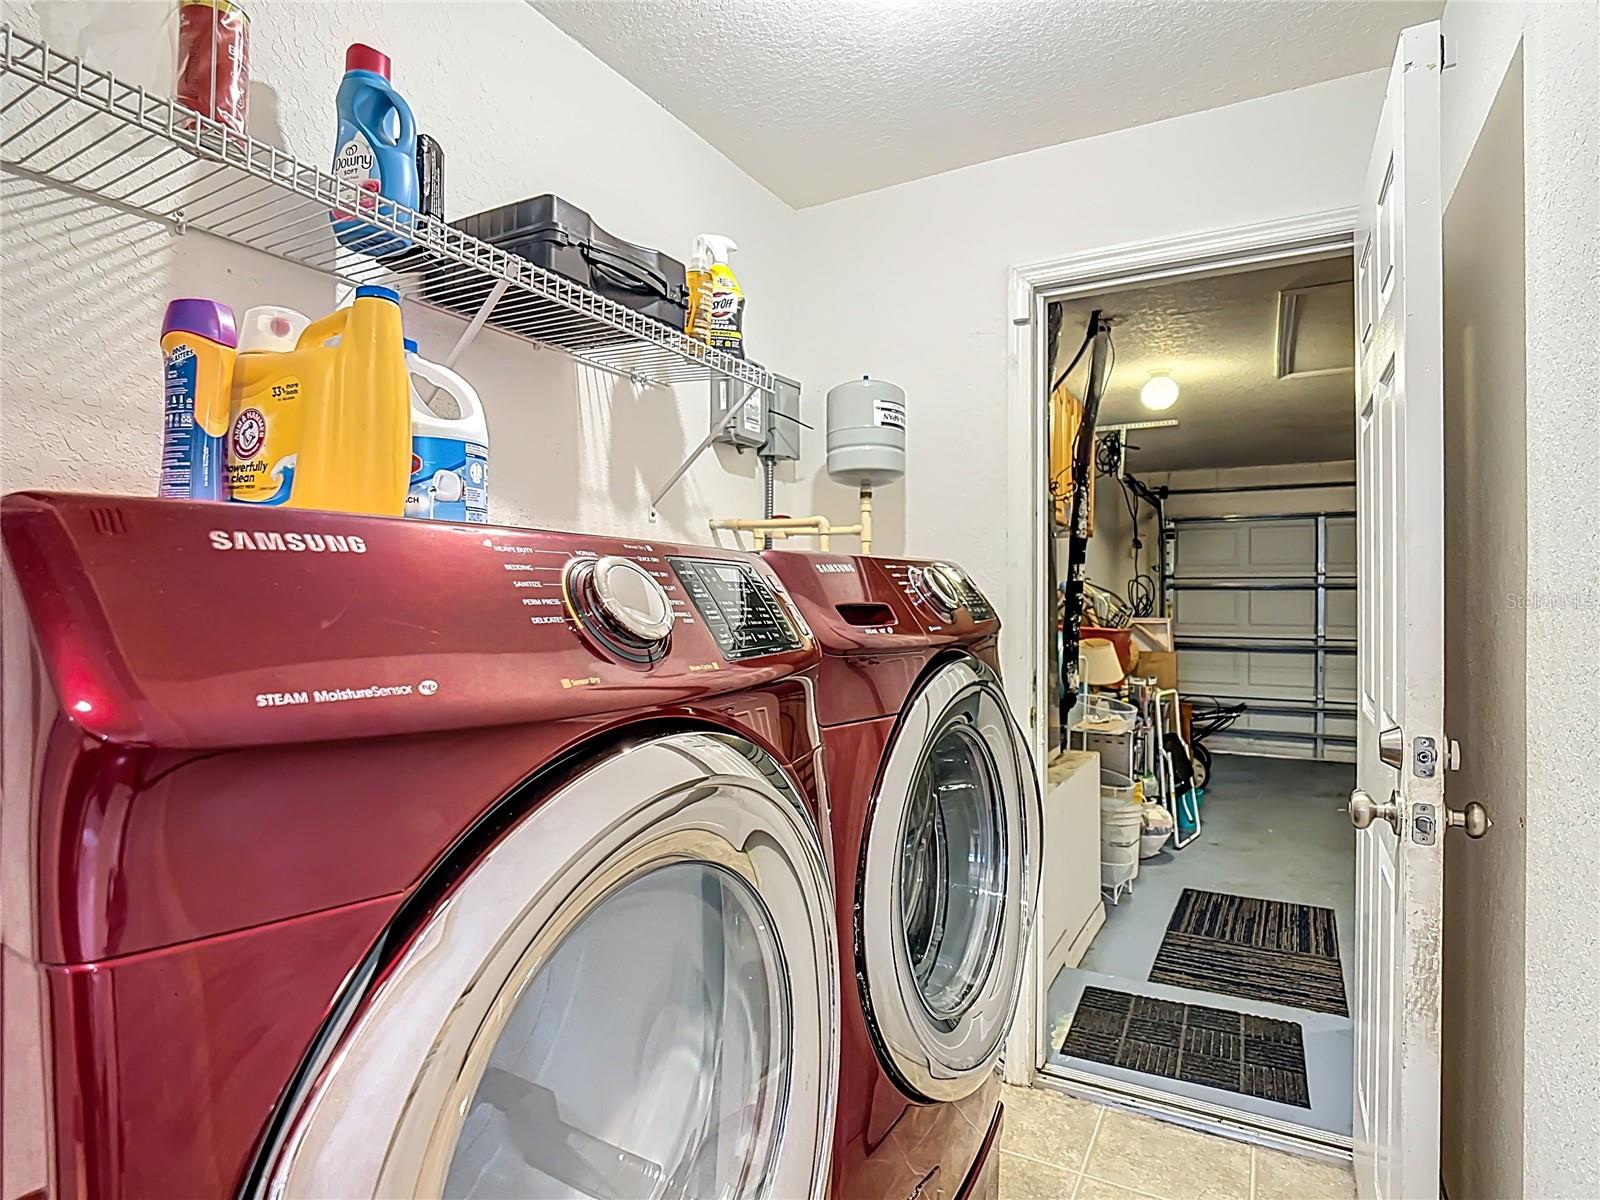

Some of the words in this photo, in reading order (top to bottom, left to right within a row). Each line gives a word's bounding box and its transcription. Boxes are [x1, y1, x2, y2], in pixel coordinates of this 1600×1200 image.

[231, 473, 255, 483] clean
[208, 530, 367, 554] SAMSUNG
[815, 564, 856, 574] SAMSUNG
[522, 598, 541, 606] PERM
[256, 691, 309, 707] STEAM
[312, 685, 413, 703] MoistureSensor
